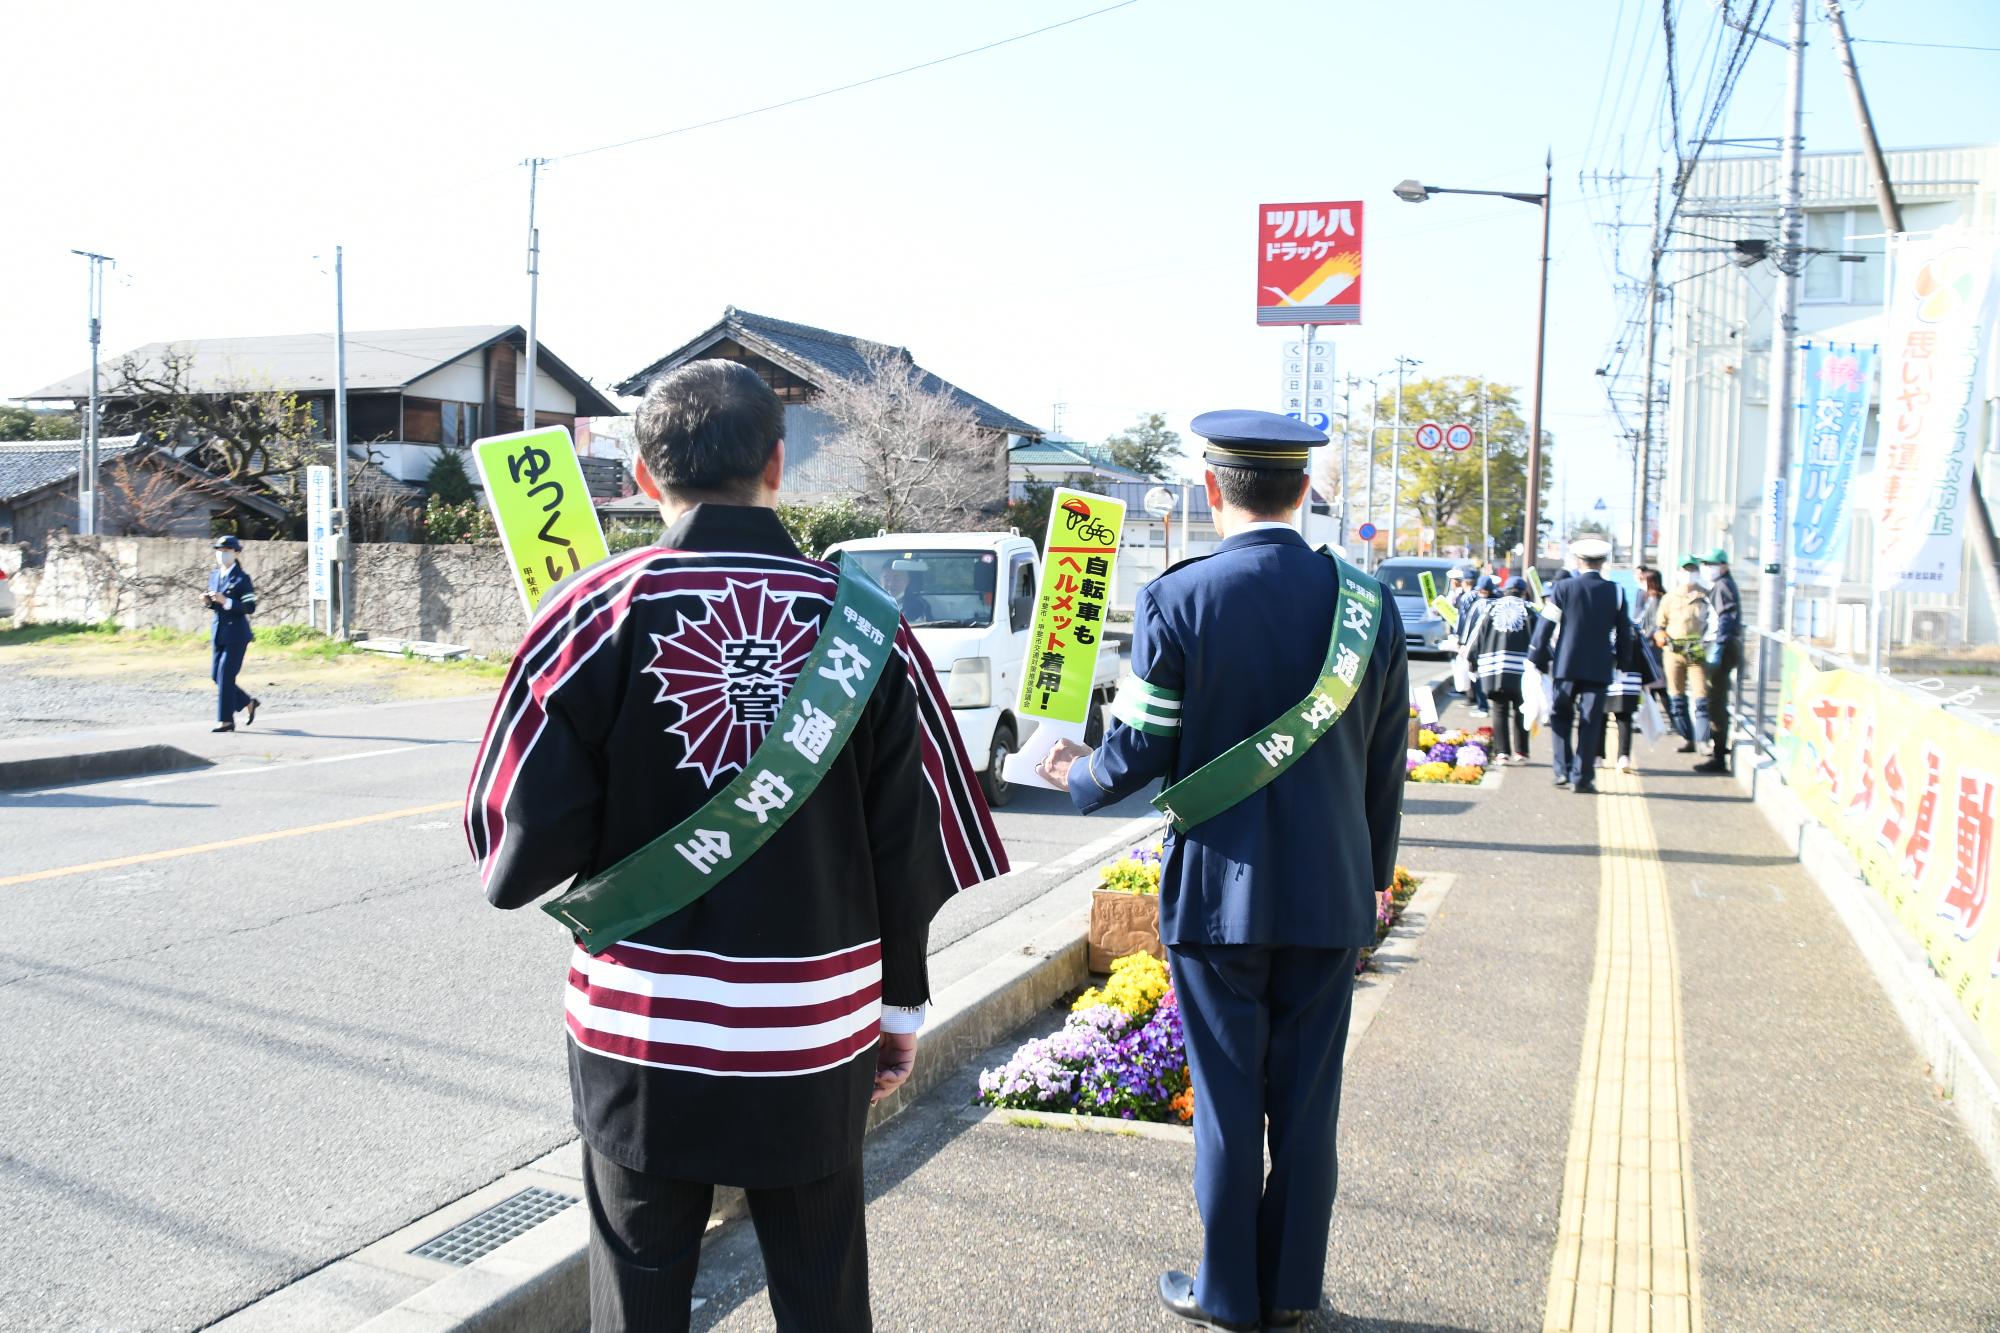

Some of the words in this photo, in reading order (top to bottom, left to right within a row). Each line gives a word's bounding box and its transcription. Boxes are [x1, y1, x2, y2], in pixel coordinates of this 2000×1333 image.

[1266, 208, 1355, 238] ツルハ
[1266, 241, 1335, 261] ドラッグ
[1291, 345, 1324, 355] くり
[1290, 363, 1324, 373] 化品
[1290, 380, 1323, 390] 日品
[1452, 430, 1468, 443] 40
[507, 445, 581, 582] ゆっくり
[1073, 556, 1109, 645] 自転車も
[1345, 578, 1376, 603] 甲斐市
[843, 605, 884, 646] 甲斐市
[1035, 556, 1083, 710] ヘルメット着用！
[724, 637, 781, 723] 安管
[1256, 598, 1373, 768] 交通安全
[674, 636, 871, 875] 交通安全
